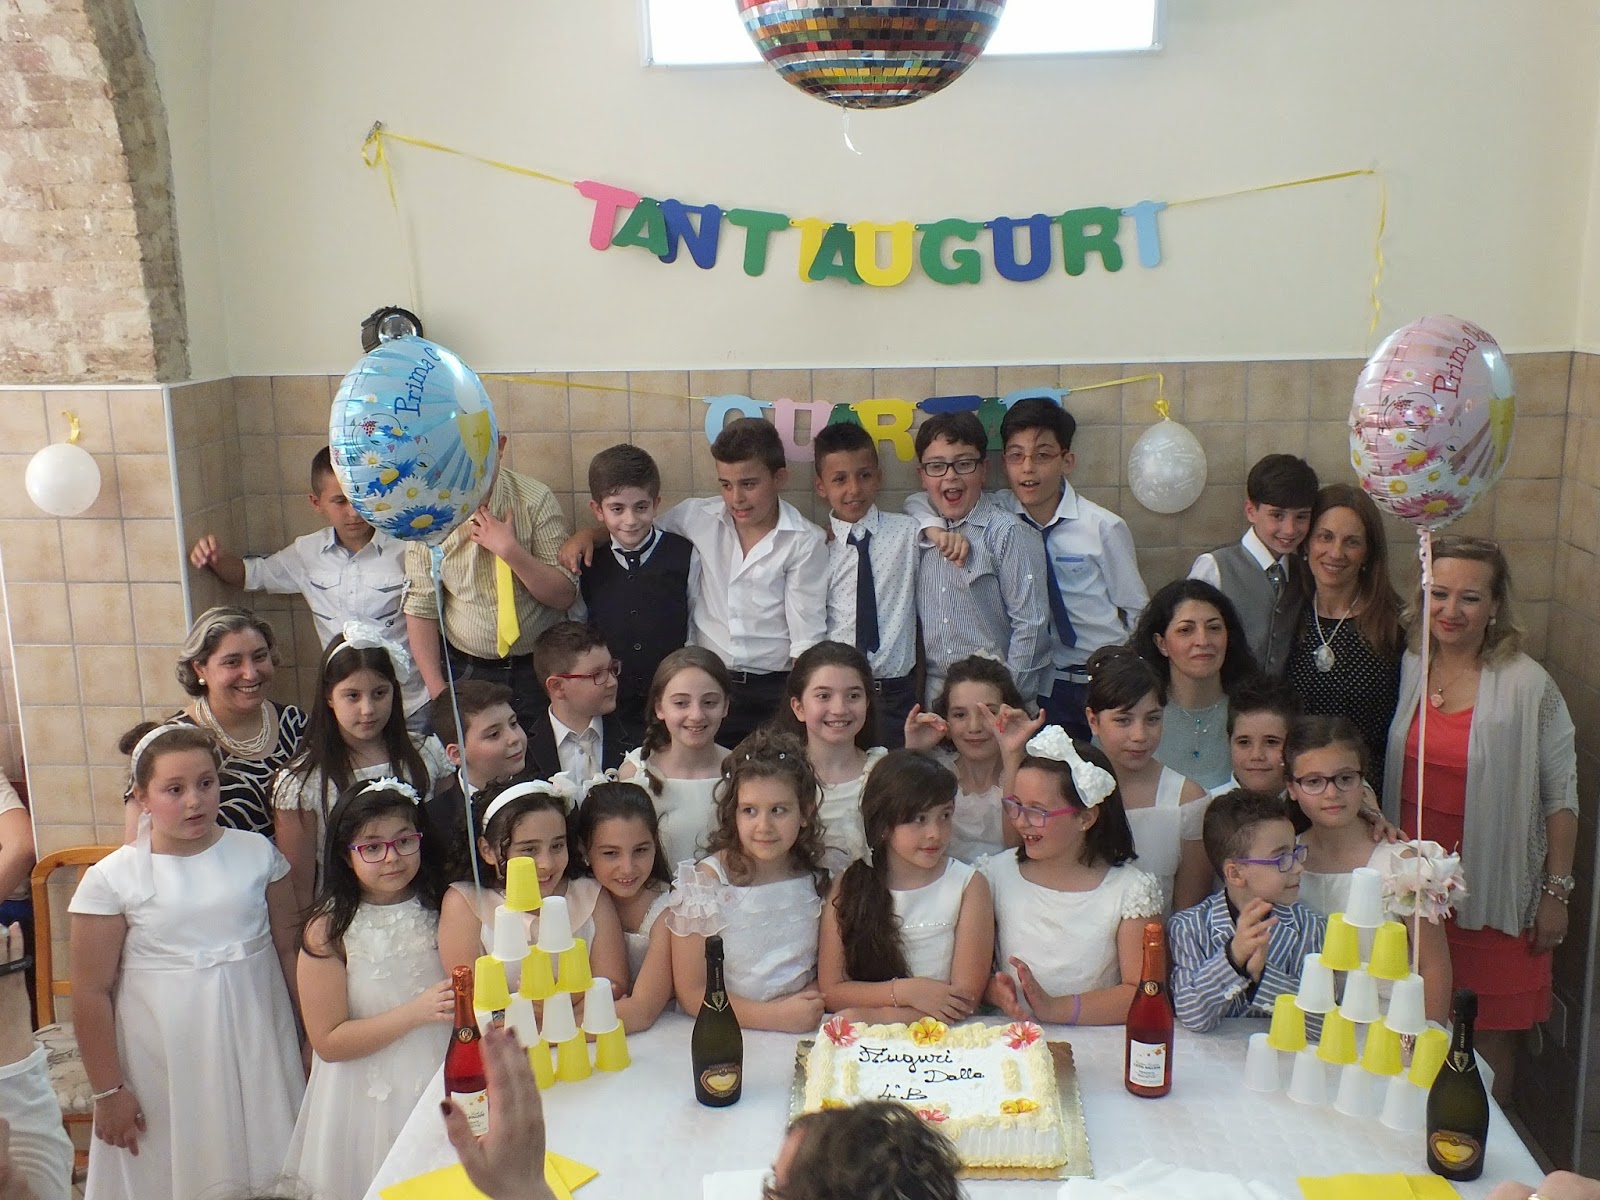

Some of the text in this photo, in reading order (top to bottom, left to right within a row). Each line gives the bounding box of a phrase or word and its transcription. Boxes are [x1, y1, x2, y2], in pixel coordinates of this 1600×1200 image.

[574, 180, 1167, 286] TANTI AUGURI
[394, 358, 435, 417] Prima
[1433, 338, 1477, 398] Prima
[858, 1045, 953, 1073] Auguri
[924, 1067, 985, 1083] Dalla
